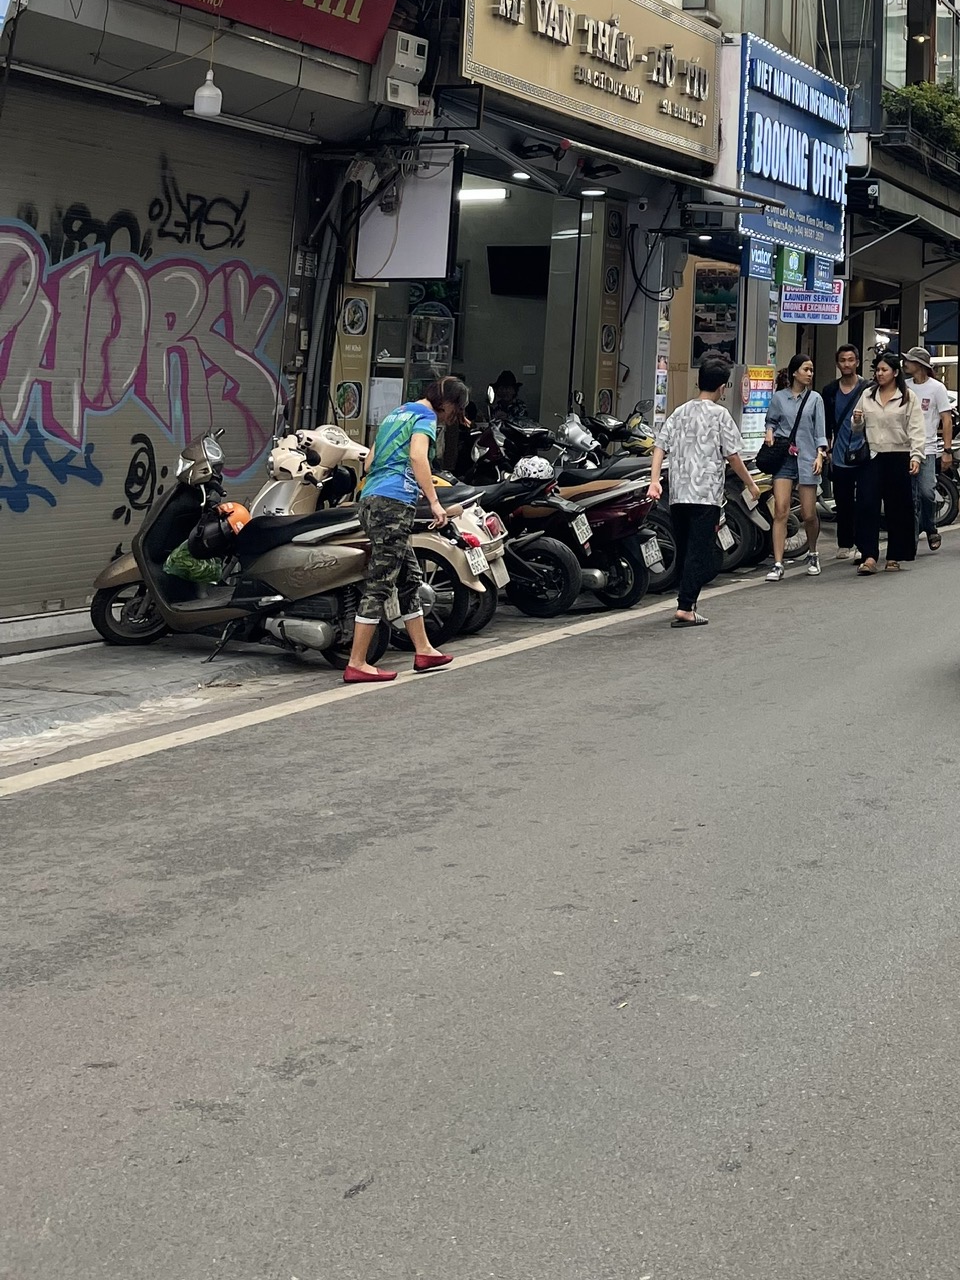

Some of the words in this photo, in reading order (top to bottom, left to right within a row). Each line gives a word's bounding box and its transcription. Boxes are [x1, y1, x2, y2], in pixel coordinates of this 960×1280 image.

[773, 67, 791, 102] NAM
[753, 111, 809, 191] BOOKING
[812, 138, 848, 207] OFFICE
[783, 302, 806, 312] MONEY
[806, 303, 839, 313] EXCHANGE
[784, 293, 812, 302] LAUNDRY
[813, 294, 839, 303] SERVICE
